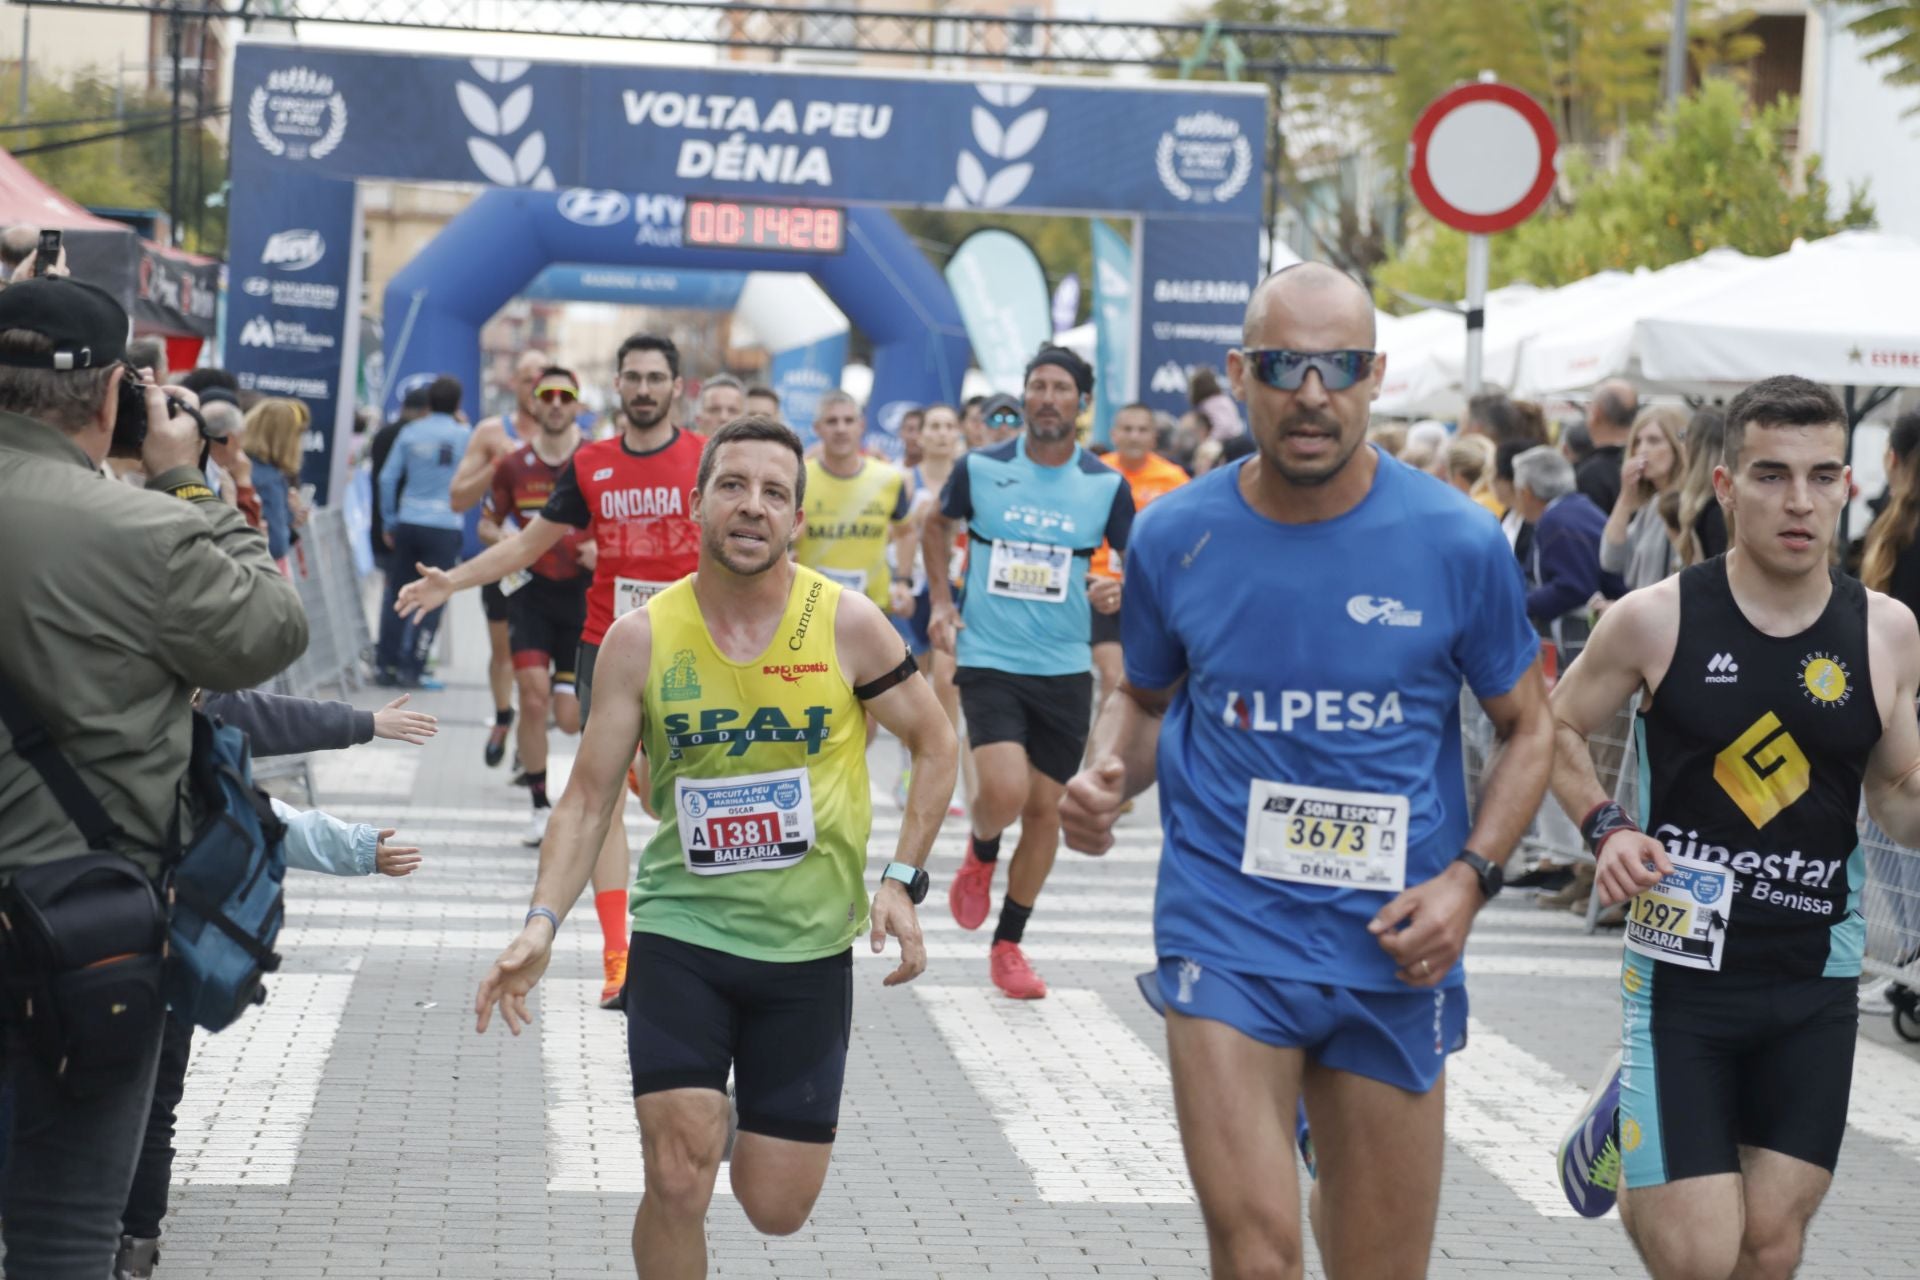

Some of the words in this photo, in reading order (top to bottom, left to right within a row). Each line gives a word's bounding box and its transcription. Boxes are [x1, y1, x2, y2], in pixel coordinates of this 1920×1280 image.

[623, 90, 760, 132] VOLTA
[762, 99, 798, 134] A
[802, 101, 893, 139] PEU
[676, 131, 832, 186] DÉNIA
[1153, 279, 1250, 304] BALEARIA
[601, 486, 682, 519] ONDARA
[1705, 674, 1738, 683] mobel
[669, 729, 828, 746] MODULAR
[707, 790, 743, 799] CIRCUIT
[751, 786, 769, 795] PEU
[714, 796, 745, 806] MARINA
[746, 795, 766, 804] ALTA
[728, 806, 754, 814] OSCAR
[1303, 801, 1338, 818] SOM
[693, 827, 706, 846] A
[713, 819, 773, 848] 1381
[1290, 818, 1366, 852] 3673
[715, 845, 780, 862] BALEARIA
[1301, 864, 1352, 880] DÉNIA
[1751, 881, 1833, 915] Benissa
[1634, 895, 1688, 931] 1297
[1630, 922, 1683, 950] BALEARIA
